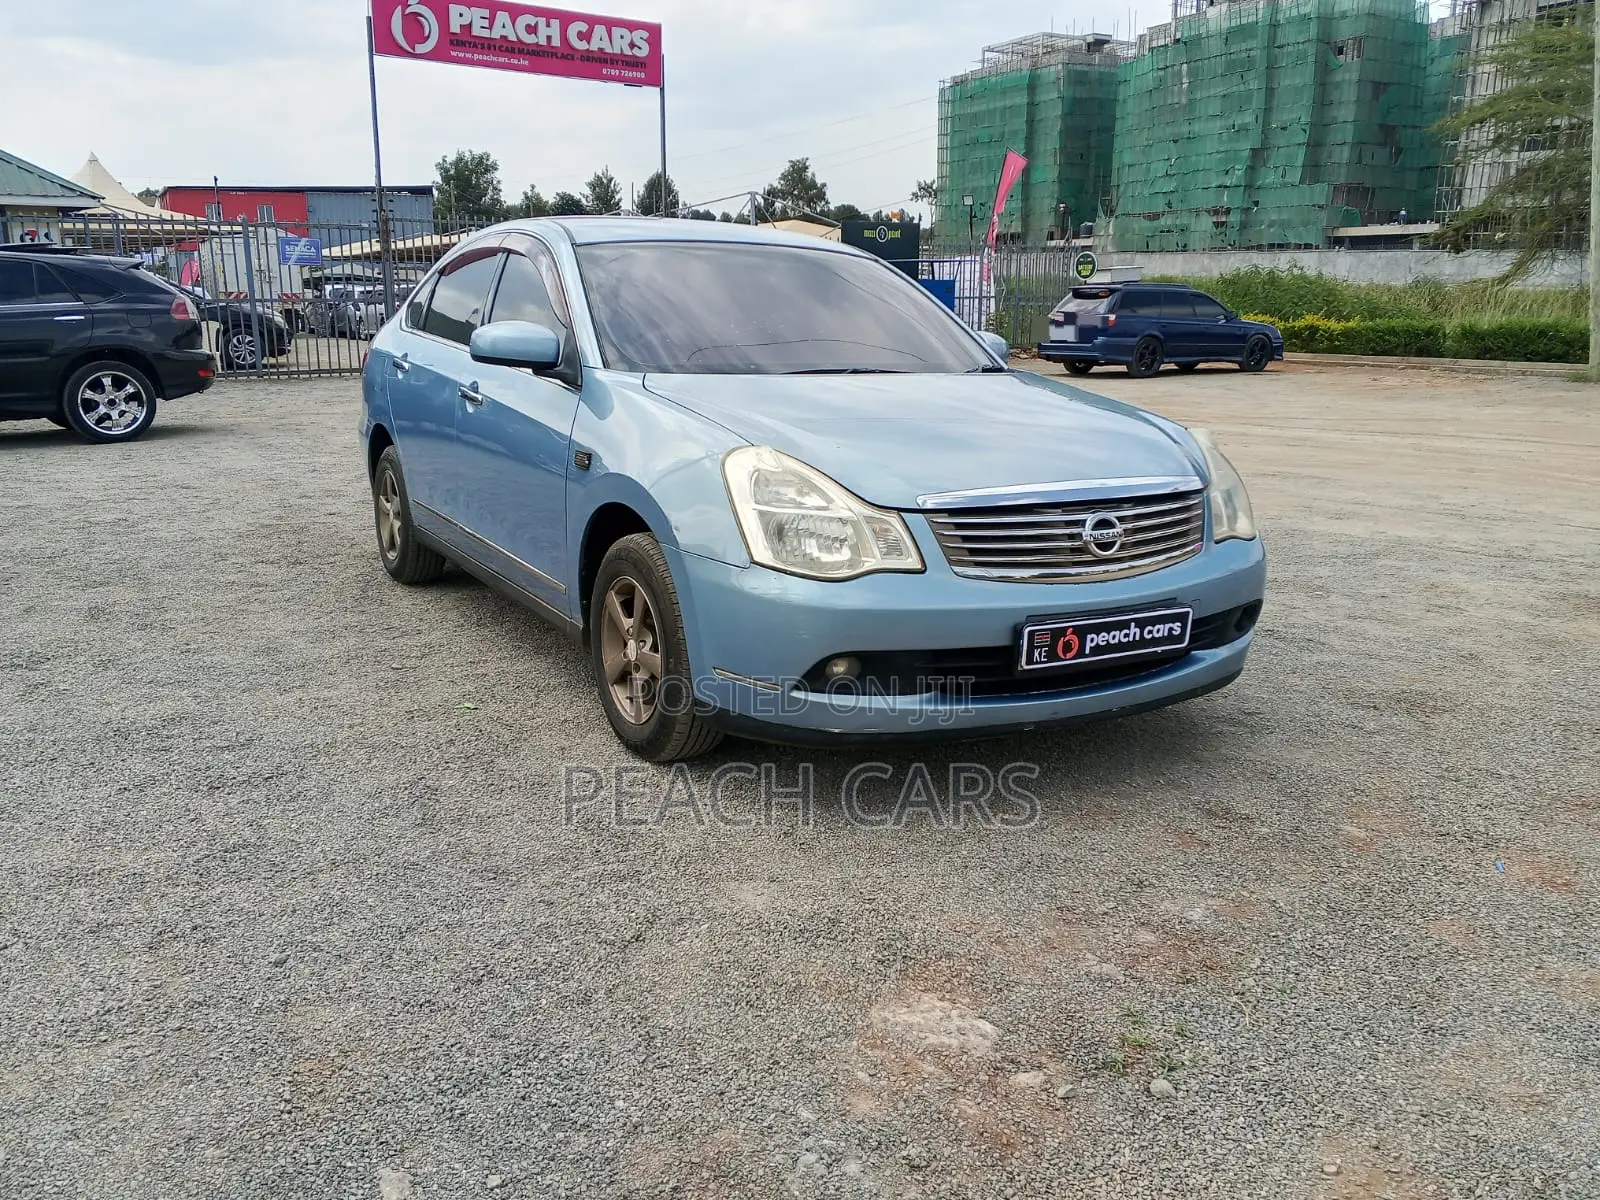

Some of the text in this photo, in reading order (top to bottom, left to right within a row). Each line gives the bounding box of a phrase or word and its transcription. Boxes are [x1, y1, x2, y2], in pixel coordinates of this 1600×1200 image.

[448, 3, 650, 57] PEACH CARS
[449, 38, 486, 50] KENYA'S
[498, 44, 516, 54] CAR
[517, 46, 575, 60] MARKETPLACE
[580, 54, 608, 65] DRIVEN
[609, 58, 620, 66] BY
[449, 50, 529, 65] www.peachcars.co.ke
[602, 67, 620, 76] 0709
[1089, 530, 1122, 541] NISSAN
[1085, 622, 1182, 654] peach cars
[1033, 647, 1048, 662] KE
